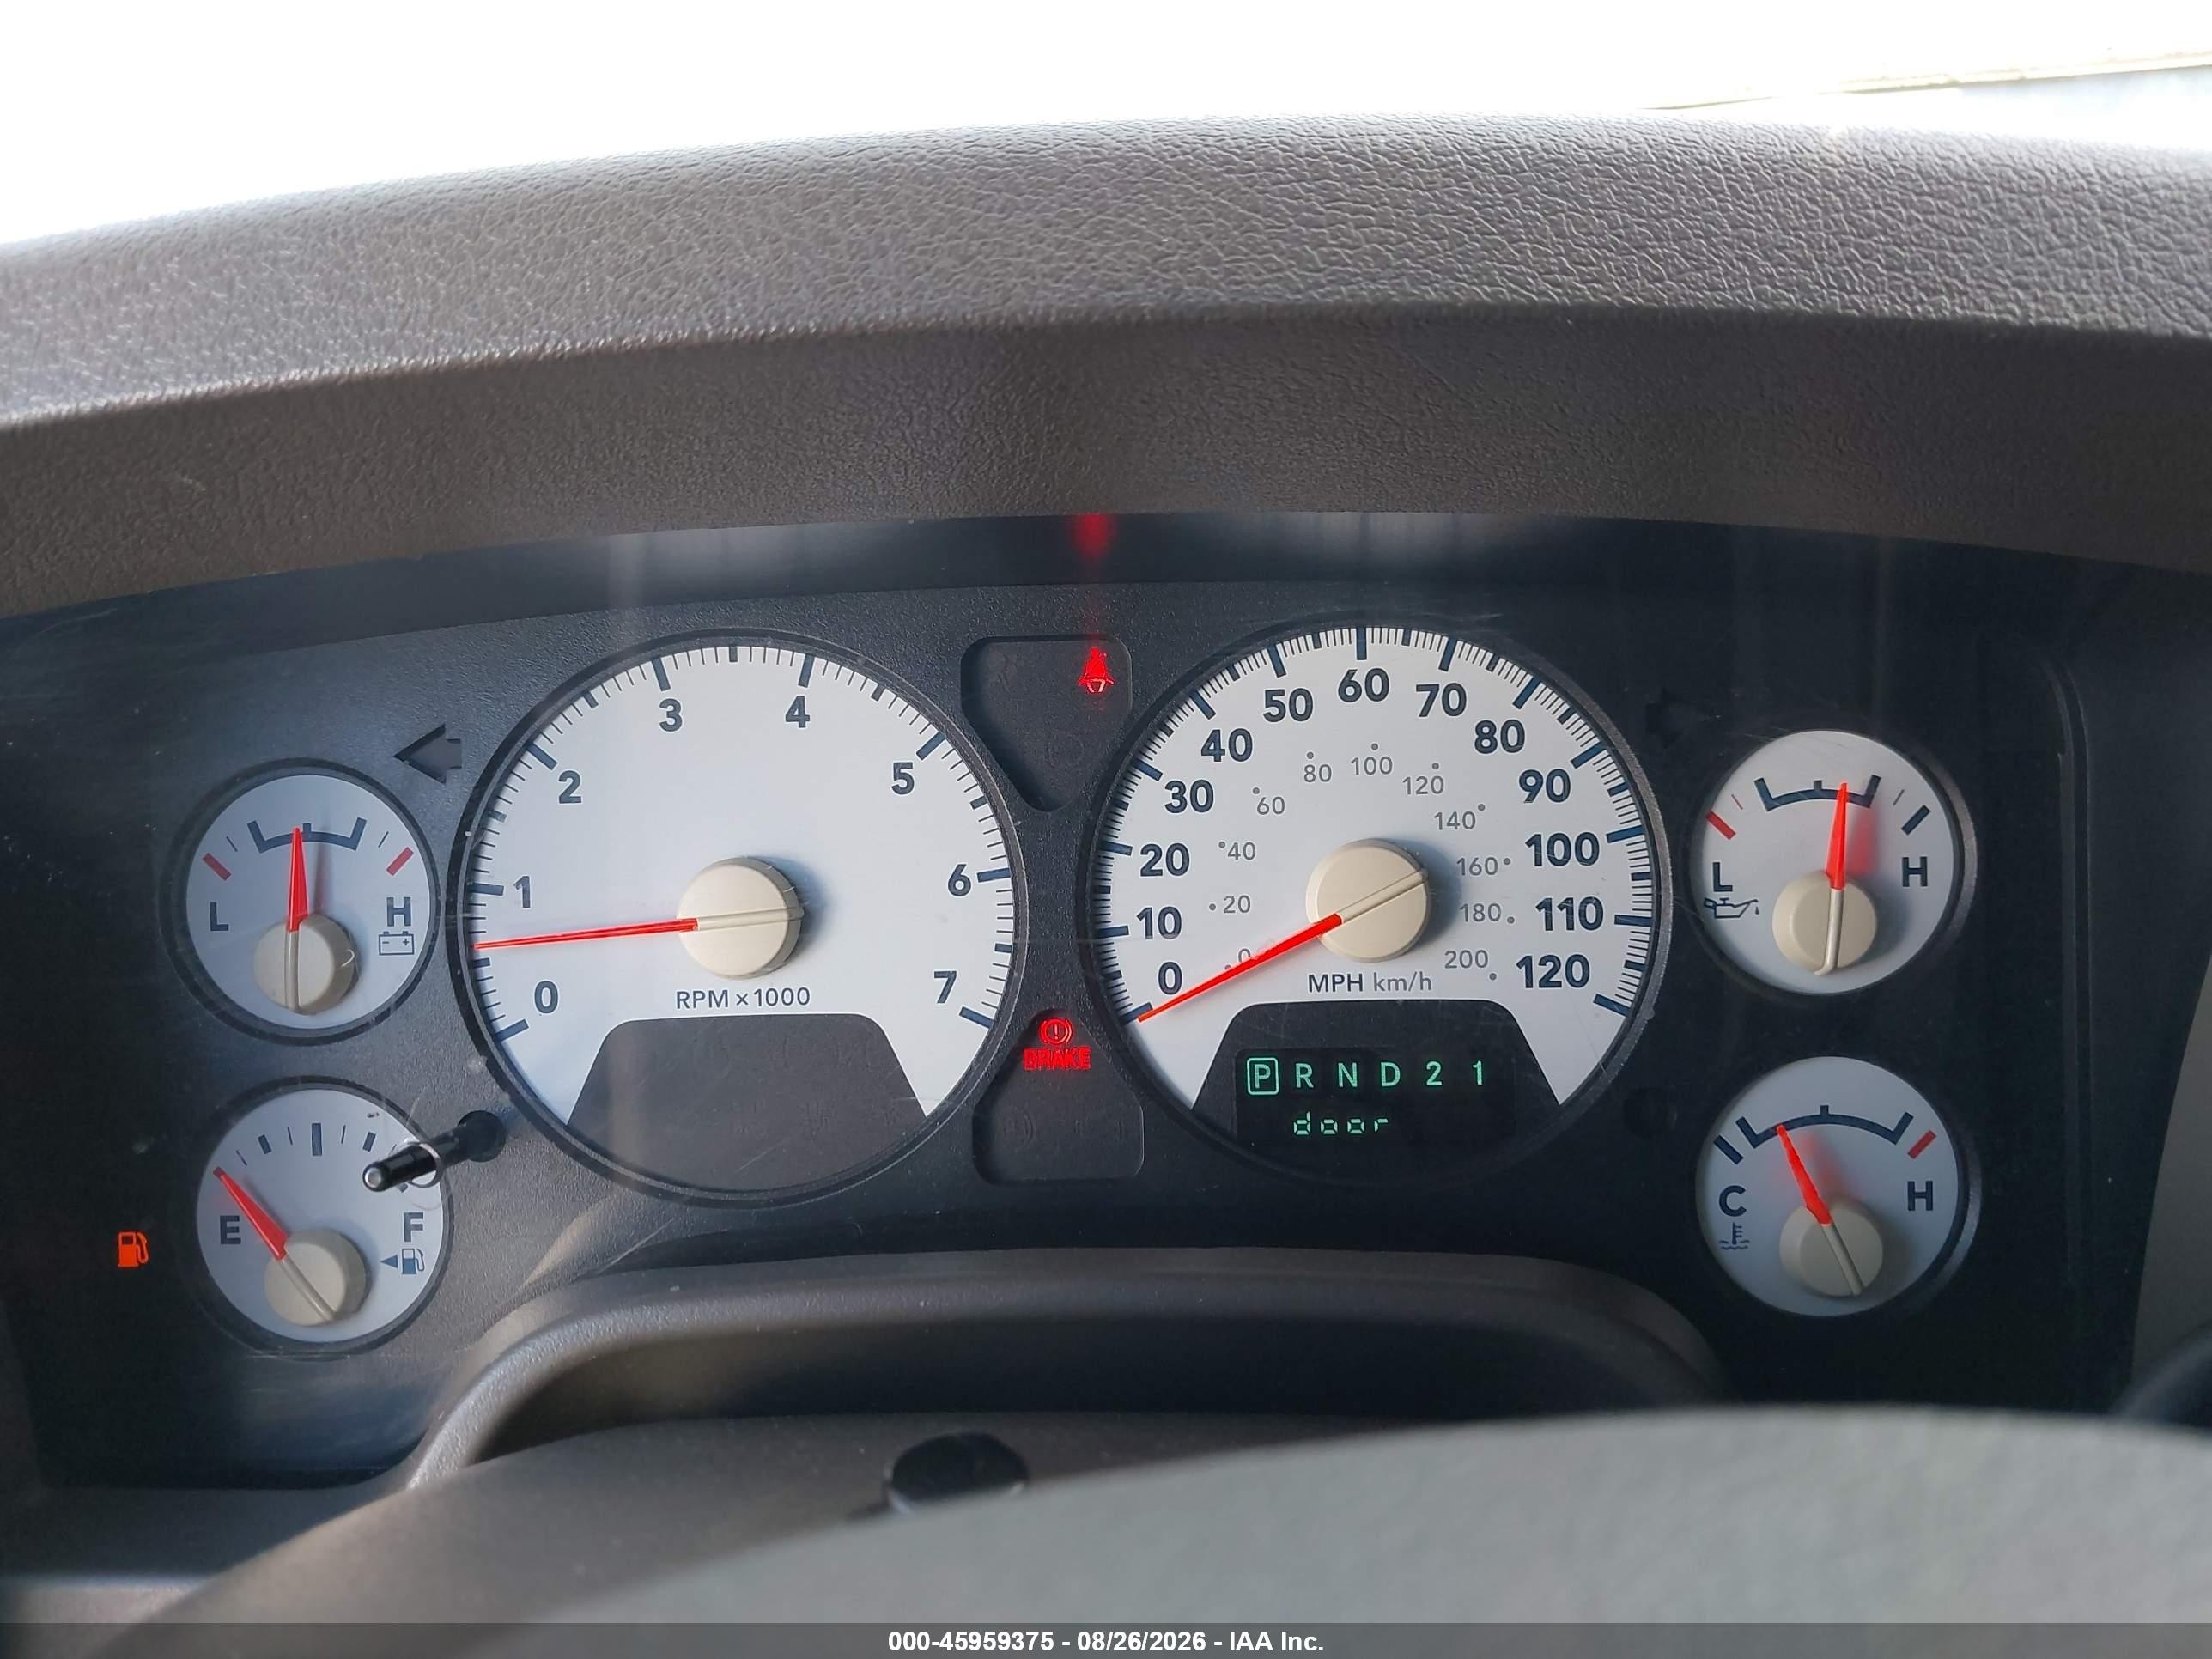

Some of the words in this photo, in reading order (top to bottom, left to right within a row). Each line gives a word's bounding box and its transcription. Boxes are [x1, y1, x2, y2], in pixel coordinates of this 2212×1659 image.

[1338, 668, 1389, 702] 60
[1416, 683, 1466, 717] 70
[659, 699, 682, 732] 3
[786, 696, 810, 728] 4
[1264, 688, 1313, 722] 50
[1201, 728, 1252, 762] 40
[1475, 720, 1525, 754] 80
[892, 763, 914, 794] 5
[1304, 764, 1331, 782] 80
[1352, 757, 1392, 775] 100
[559, 770, 581, 804] 2
[1165, 780, 1213, 813] 30
[1403, 776, 1443, 794] 120
[1519, 769, 1571, 803] 90
[1256, 797, 1285, 815] 60
[1434, 811, 1475, 830] 140
[1140, 844, 1189, 876] 20
[1228, 842, 1255, 860] 40
[1525, 832, 1599, 866] 100
[948, 864, 971, 896] 6
[1457, 858, 1498, 877] 160
[1713, 862, 1733, 892] L
[1903, 857, 1927, 887] H
[514, 876, 530, 908] 1
[1224, 896, 1250, 913] 20
[210, 902, 228, 931] L
[387, 897, 411, 927] H
[1137, 907, 1182, 939] 10
[1461, 903, 1501, 921] 180
[1535, 898, 1603, 931] 110
[1445, 950, 1488, 969] 200
[1516, 954, 1589, 988] 120
[934, 971, 957, 1003] 7
[1158, 962, 1182, 994] 0
[1309, 974, 1363, 992] MPH
[1374, 971, 1431, 991] km/h
[535, 981, 558, 1013] 0
[677, 990, 728, 1009] RPM
[1024, 1046, 1091, 1071] BRAKE
[1255, 1064, 1270, 1088] P
[1296, 1063, 1313, 1087] R
[1339, 1063, 1357, 1087] N
[1381, 1062, 1400, 1086] D
[1427, 1061, 1442, 1085] 2
[1474, 1061, 1482, 1085] 1
[1294, 1112, 1388, 1134] door
[1719, 1186, 1747, 1217] C
[1908, 1181, 1933, 1211] H
[220, 1216, 241, 1244] E
[404, 1212, 423, 1242] F
